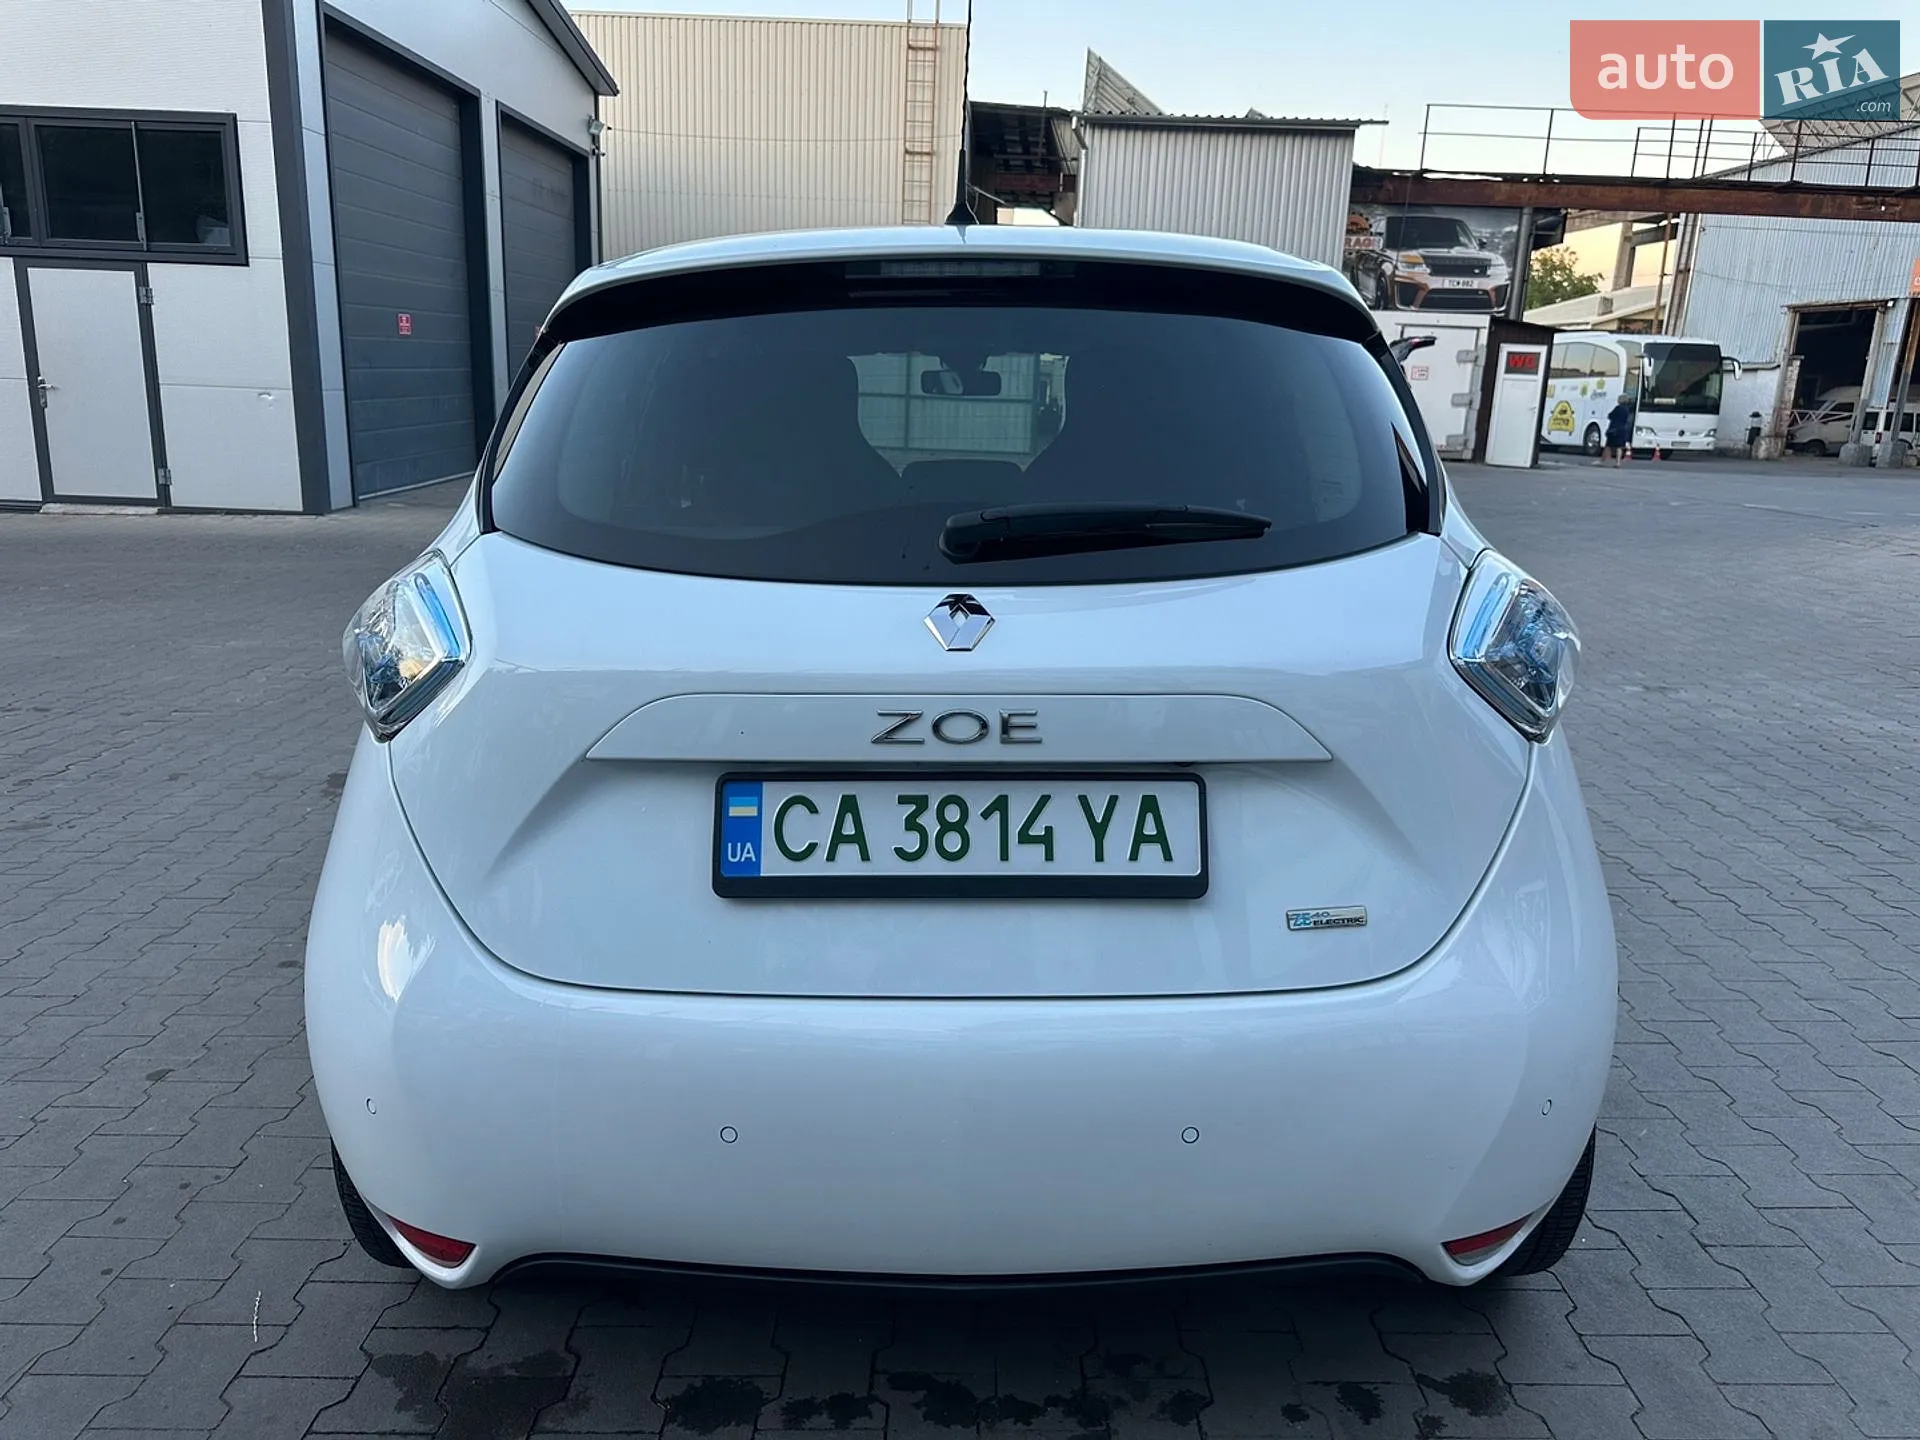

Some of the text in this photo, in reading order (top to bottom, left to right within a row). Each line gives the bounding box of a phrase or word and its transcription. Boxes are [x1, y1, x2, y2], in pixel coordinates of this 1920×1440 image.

[1508, 354, 1536, 370] WC
[871, 709, 1043, 745] ZOE
[773, 793, 1174, 863] CA 3814 YA
[727, 842, 756, 863] UA
[1313, 916, 1364, 926] ELECTRIC
